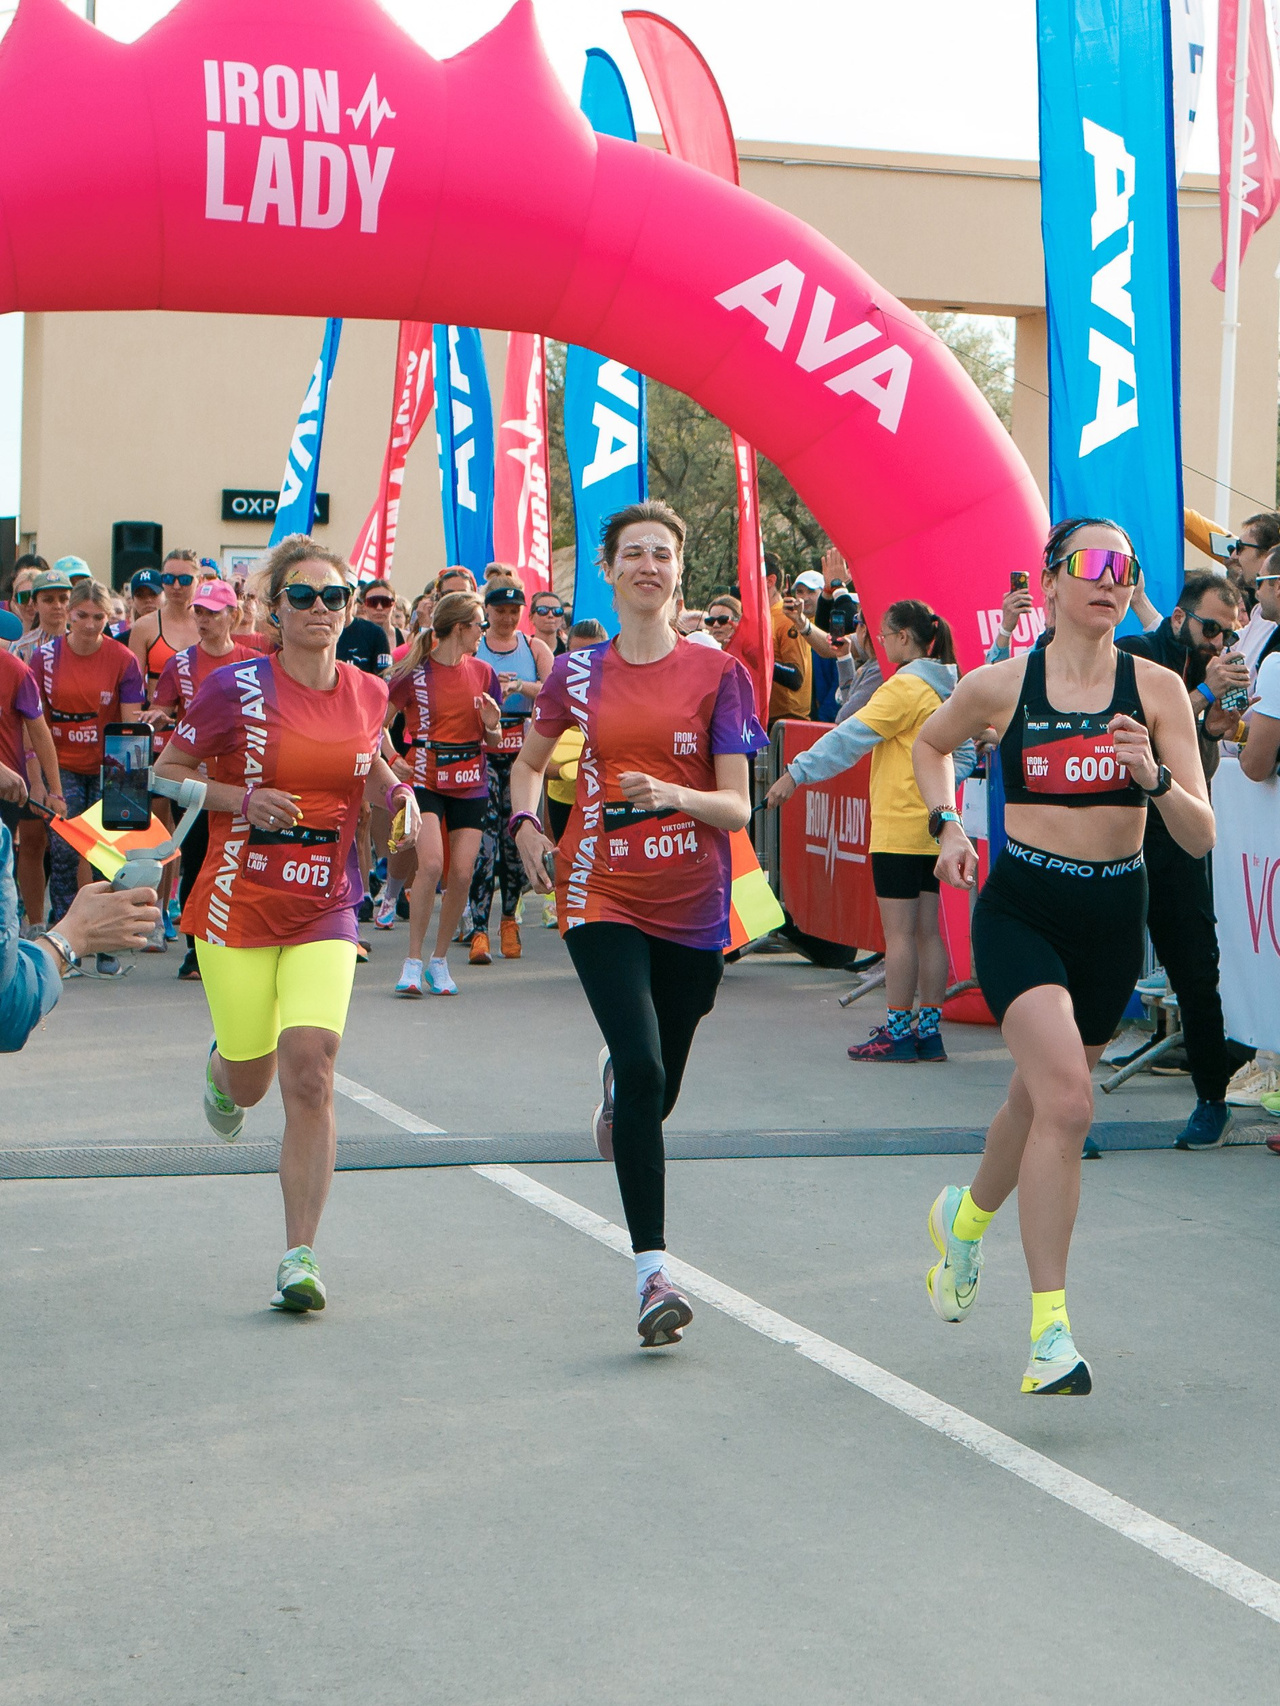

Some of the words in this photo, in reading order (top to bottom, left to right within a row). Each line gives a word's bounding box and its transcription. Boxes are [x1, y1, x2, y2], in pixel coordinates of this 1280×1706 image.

[203, 59, 339, 134] IRON
[205, 130, 395, 234] LADY
[1079, 117, 1139, 458] AVA
[714, 259, 913, 435] AVA
[234, 664, 267, 721] AVA
[67, 730, 99, 743] 6052
[674, 731, 692, 743] IRON
[1055, 722, 1072, 730] AVA
[1027, 756, 1043, 765] IRON
[1027, 765, 1049, 776] LADY
[455, 768, 481, 784] 6024
[661, 820, 696, 833] VIKTORIYA
[839, 795, 867, 846] LADY
[610, 846, 629, 857] LADY
[644, 830, 698, 860] 6014
[214, 839, 246, 898] AVA
[247, 858, 268, 872] LADY
[310, 854, 332, 864] MARIYA
[1006, 840, 1047, 867] NIKE
[1045, 857, 1095, 878] PRO
[1101, 856, 1141, 878] NIKE
[282, 860, 331, 888] 6013
